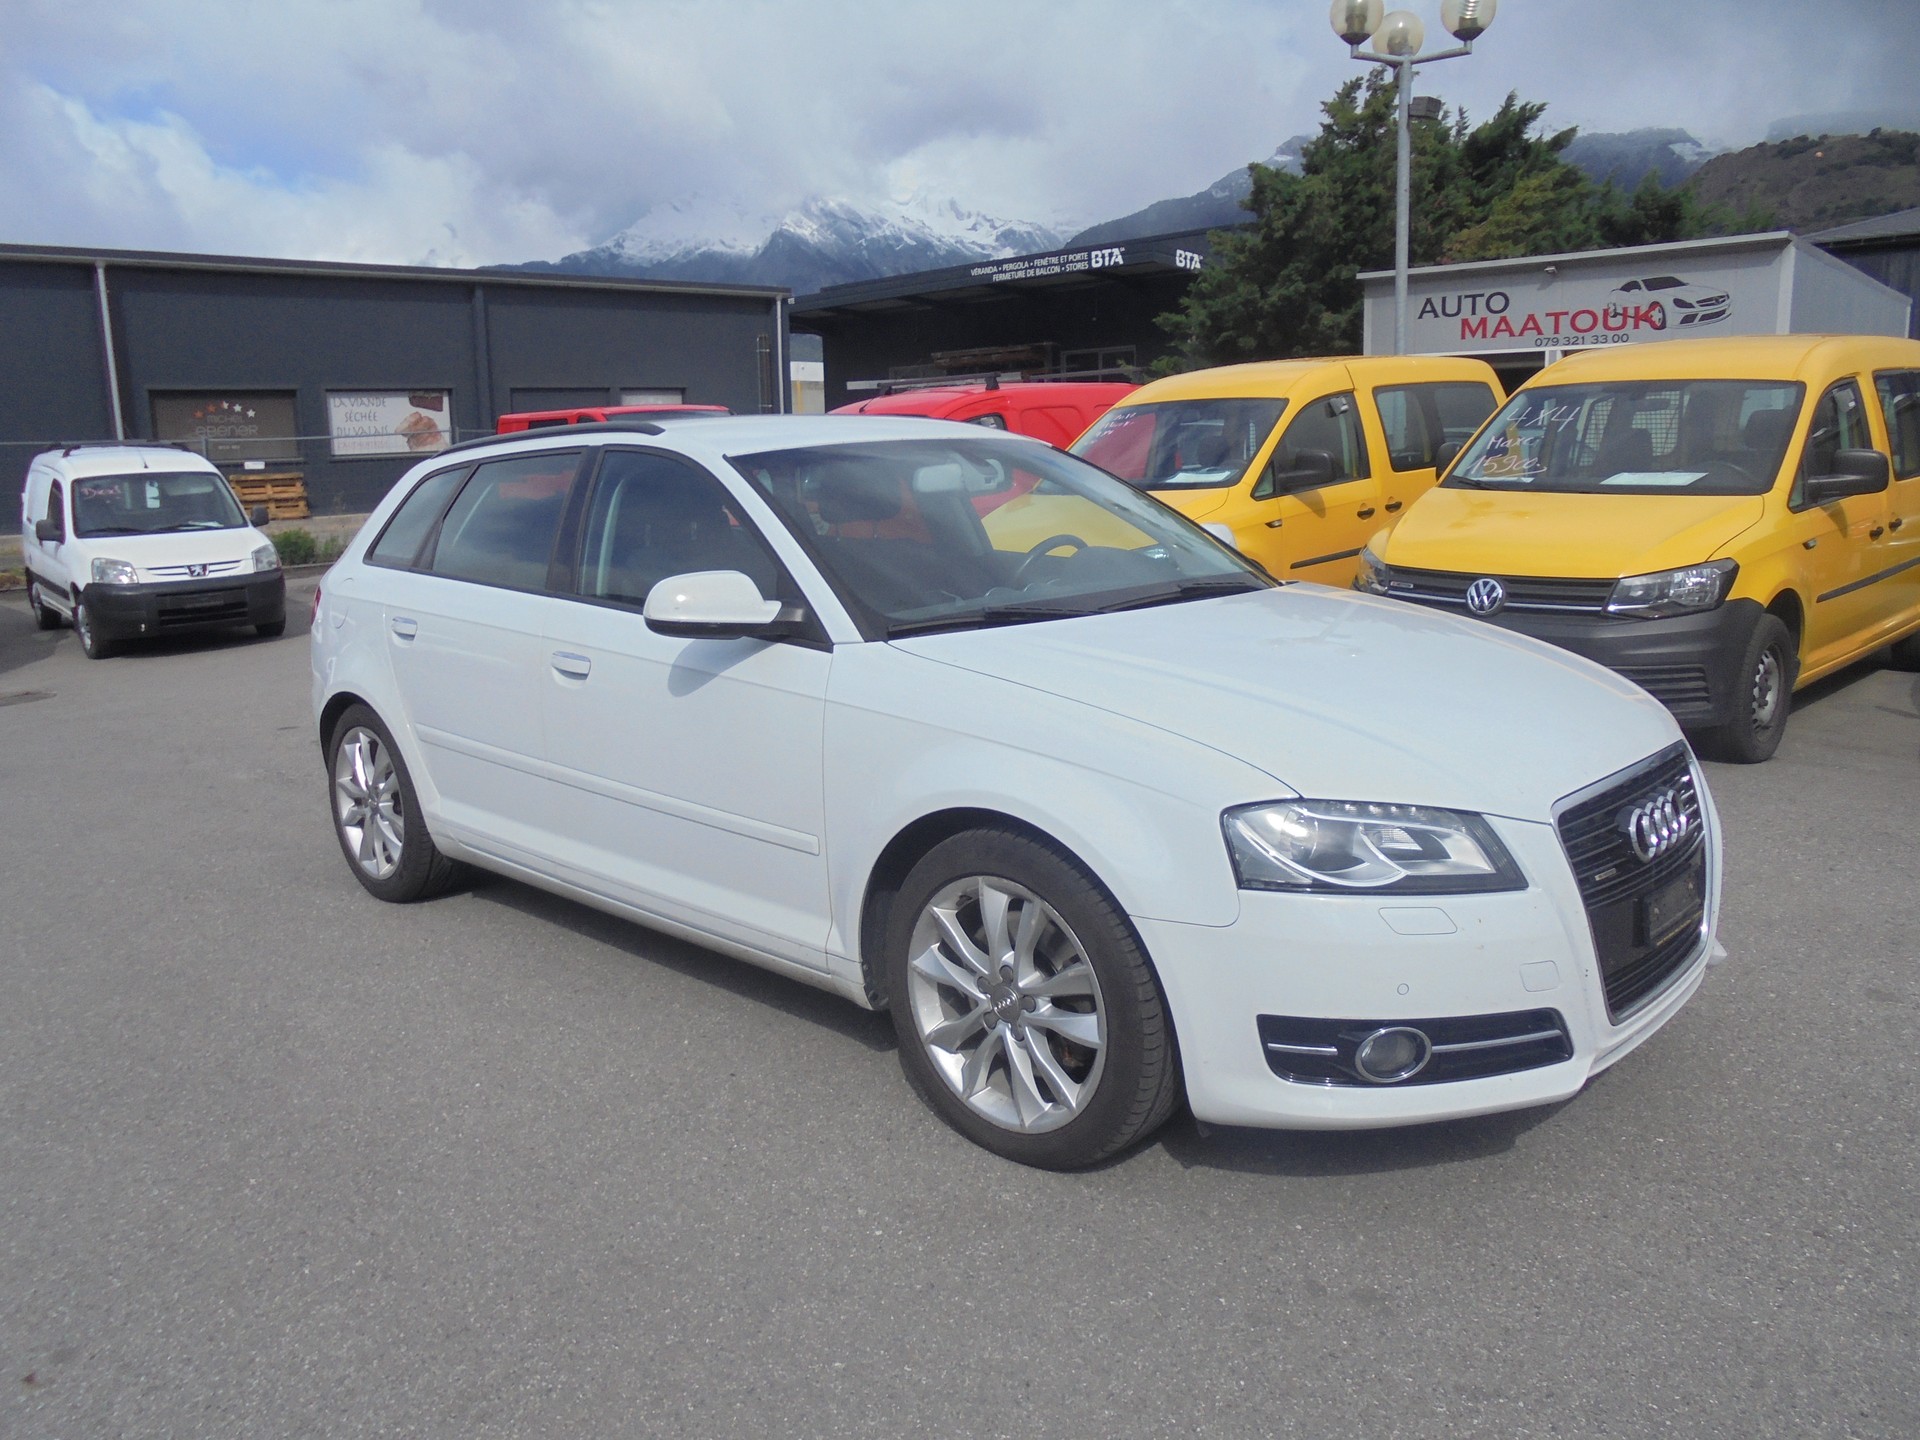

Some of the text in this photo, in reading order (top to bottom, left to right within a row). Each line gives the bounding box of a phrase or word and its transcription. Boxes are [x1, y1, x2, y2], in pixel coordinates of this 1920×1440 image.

[970, 252, 1088, 276] VÉRANDA PERGOLA FENÊTRE ET PORTE
[1091, 247, 1124, 268] BTA
[1175, 249, 1201, 270] BTA
[993, 261, 1088, 282] FERMETURE DE BALCON STORES
[1417, 291, 1510, 319] AUTO
[1460, 303, 1661, 340] MAATOUK
[1534, 333, 1630, 347] 079 321 33 00
[348, 396, 387, 408] VIANDE
[344, 409, 378, 423] SÉCHÉE
